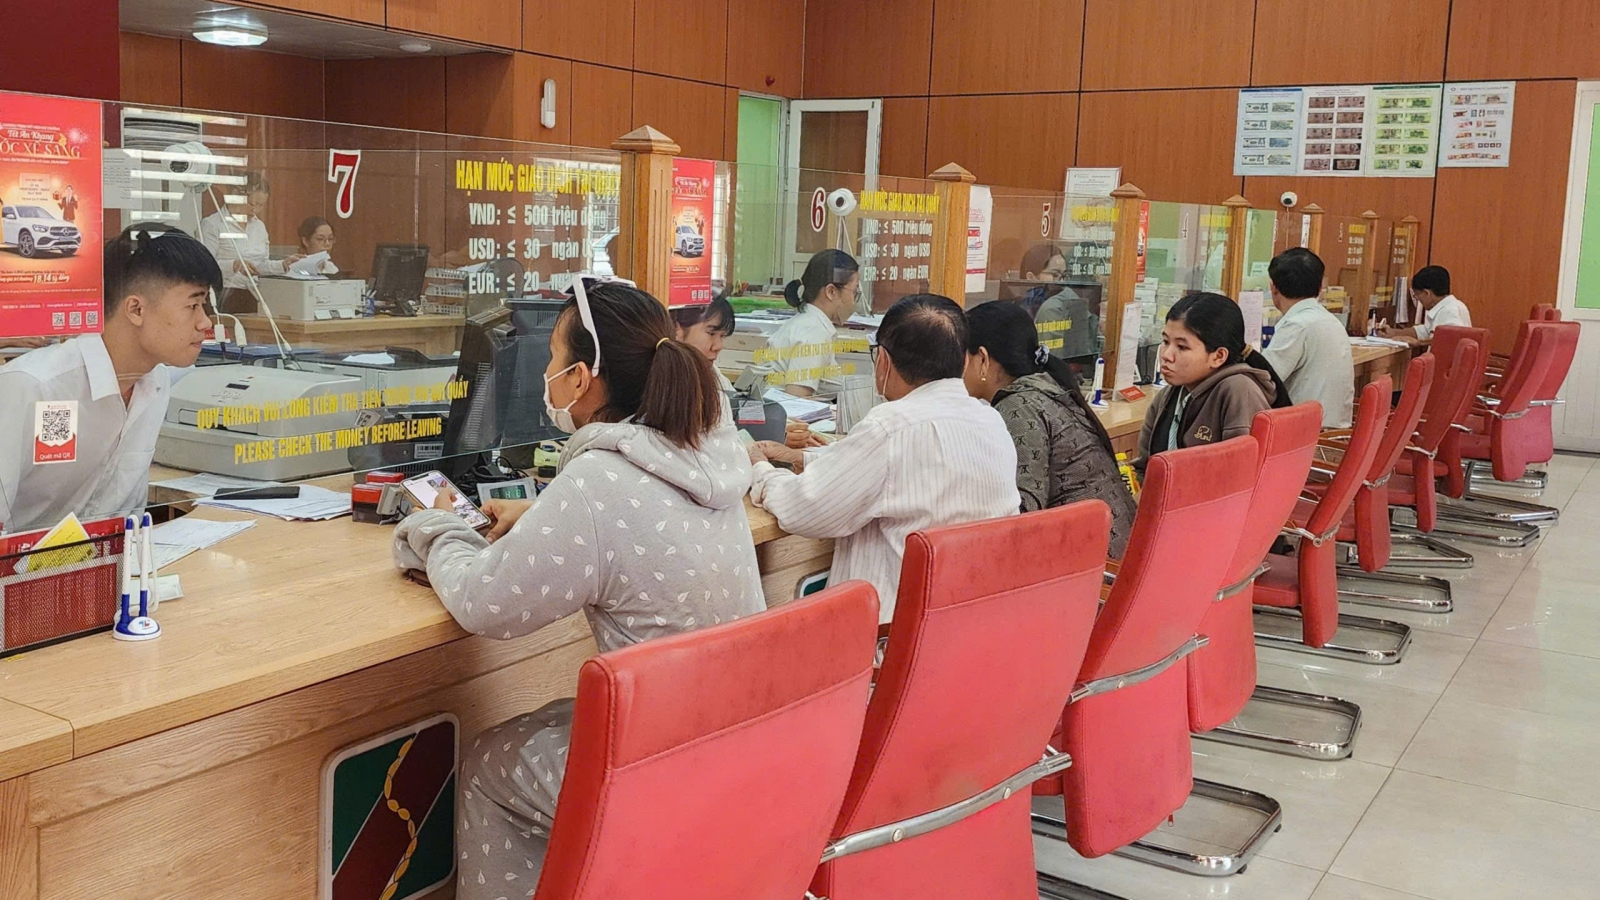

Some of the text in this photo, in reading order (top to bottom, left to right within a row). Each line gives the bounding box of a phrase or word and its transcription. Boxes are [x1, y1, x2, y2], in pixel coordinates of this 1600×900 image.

[45, 143, 80, 158] SANG
[328, 148, 361, 218] 7
[456, 159, 483, 196] HẠN
[486, 157, 514, 193] MỨC
[517, 164, 543, 192] GIAO
[469, 202, 500, 225] VND:
[524, 204, 548, 226] 500
[552, 205, 578, 231] triệu
[811, 186, 826, 232] 6
[1041, 202, 1051, 237] 5
[469, 238, 500, 259] USD:
[524, 238, 540, 259] 30
[552, 237, 579, 260] ngàn
[468, 272, 500, 294] EUR:
[523, 271, 540, 292] 20
[234, 417, 442, 465] PLEASE CHECK THE MONEY BEFORE LEAVING
